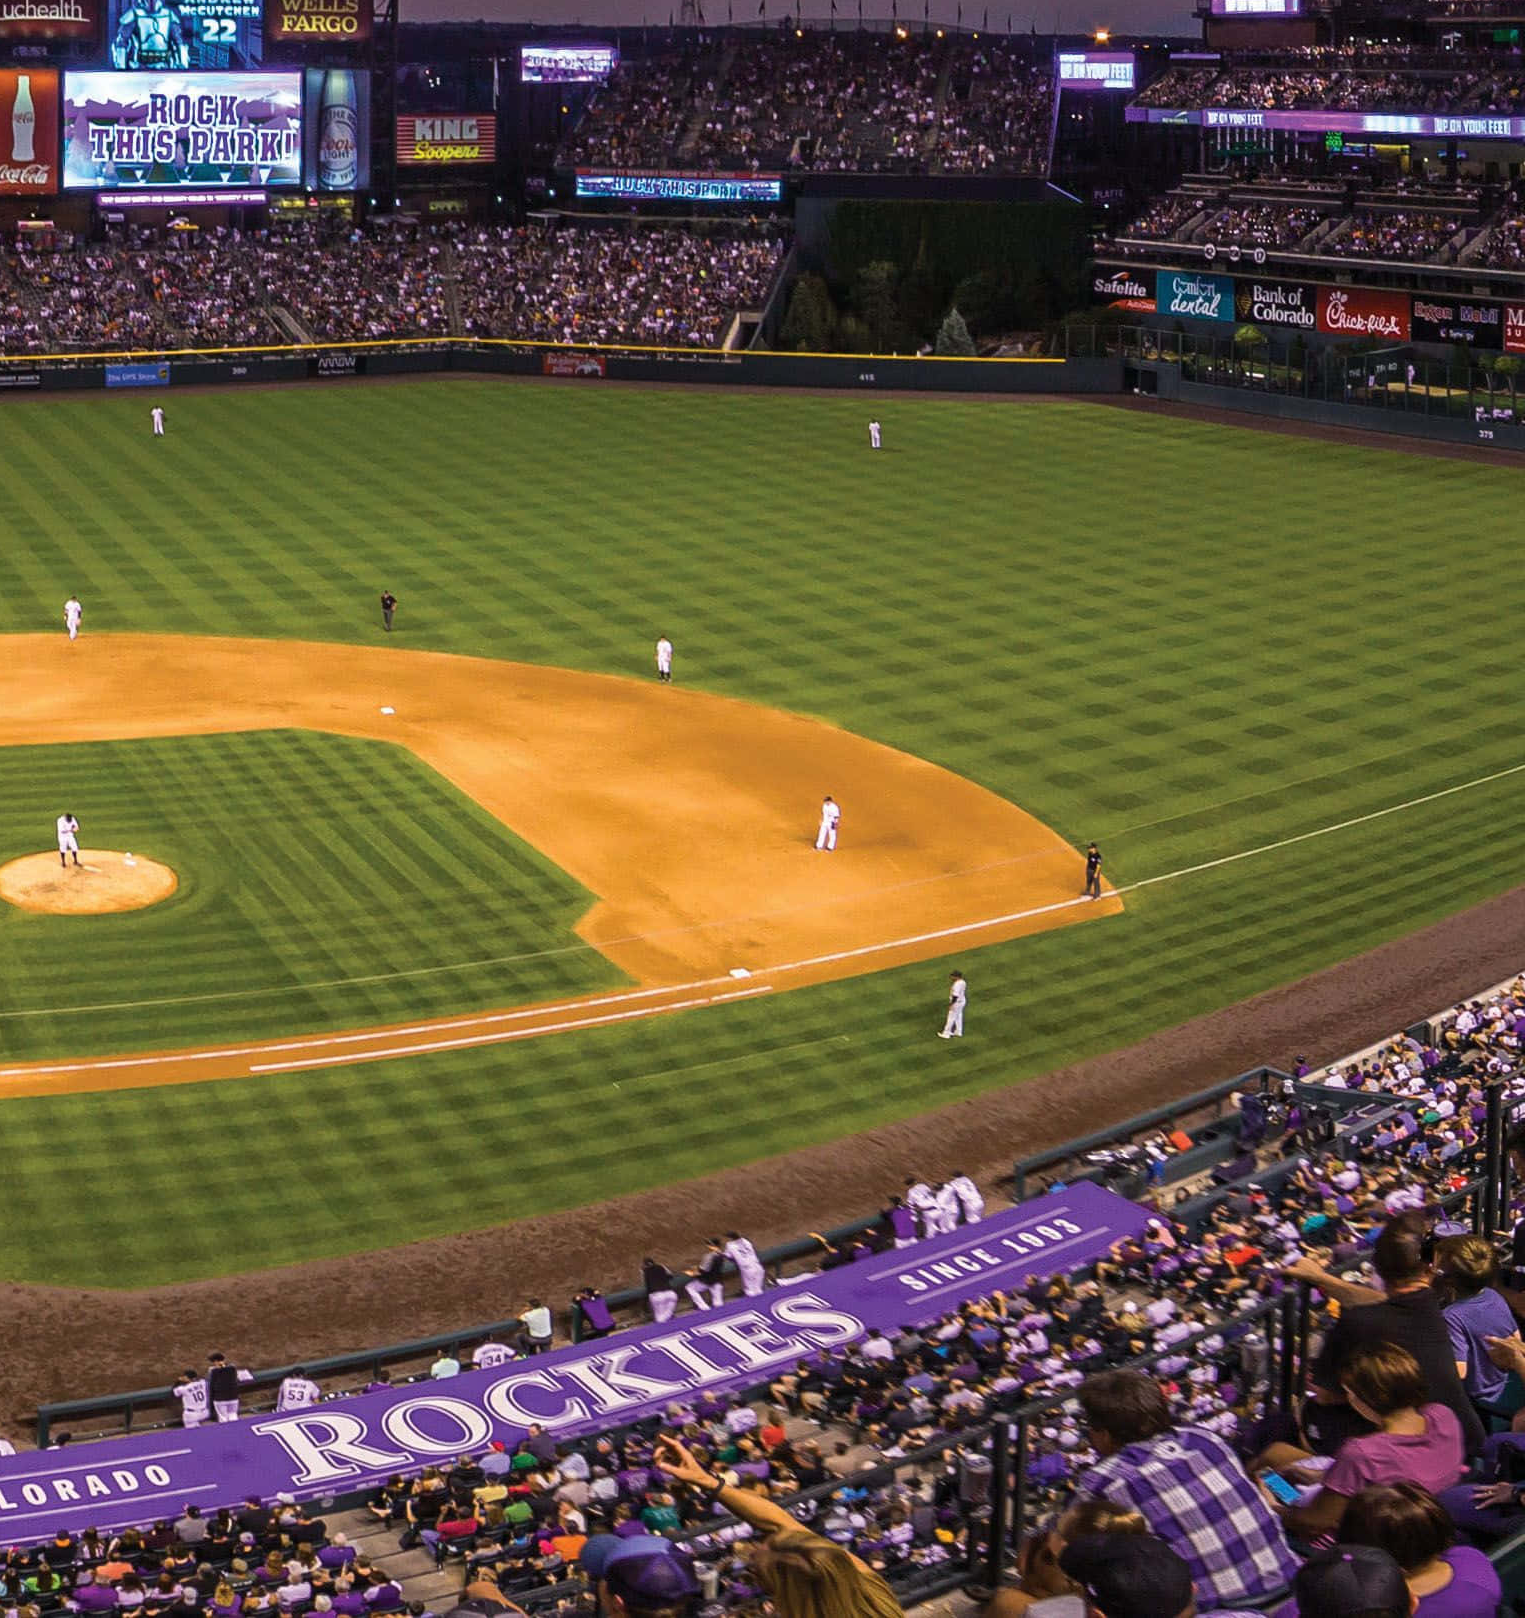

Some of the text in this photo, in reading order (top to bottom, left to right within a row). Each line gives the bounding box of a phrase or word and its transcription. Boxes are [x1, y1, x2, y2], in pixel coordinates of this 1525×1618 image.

[202, 19, 237, 42] 22
[282, 15, 358, 33] FARGO
[149, 93, 238, 125] ROCK
[412, 118, 479, 140] KING
[1435, 117, 1448, 133] UP
[1463, 118, 1487, 134] YOUR
[90, 127, 294, 163] THIS PARK!
[413, 140, 483, 162] Soopers
[612, 177, 656, 194] ROCK
[660, 179, 696, 196] THIS
[1094, 278, 1147, 297] Safelite
[1172, 276, 1217, 296] Comfort
[1253, 285, 1303, 305] Bank of
[1170, 294, 1222, 318] dental
[1253, 303, 1314, 326] Colorado
[1414, 302, 1499, 324] Exxon Mobil
[897, 1246, 1000, 1292] SINCE
[191, 1390, 205, 1403] 10
[252, 1291, 866, 1487] ROCKIES
[287, 1389, 305, 1402] 53
